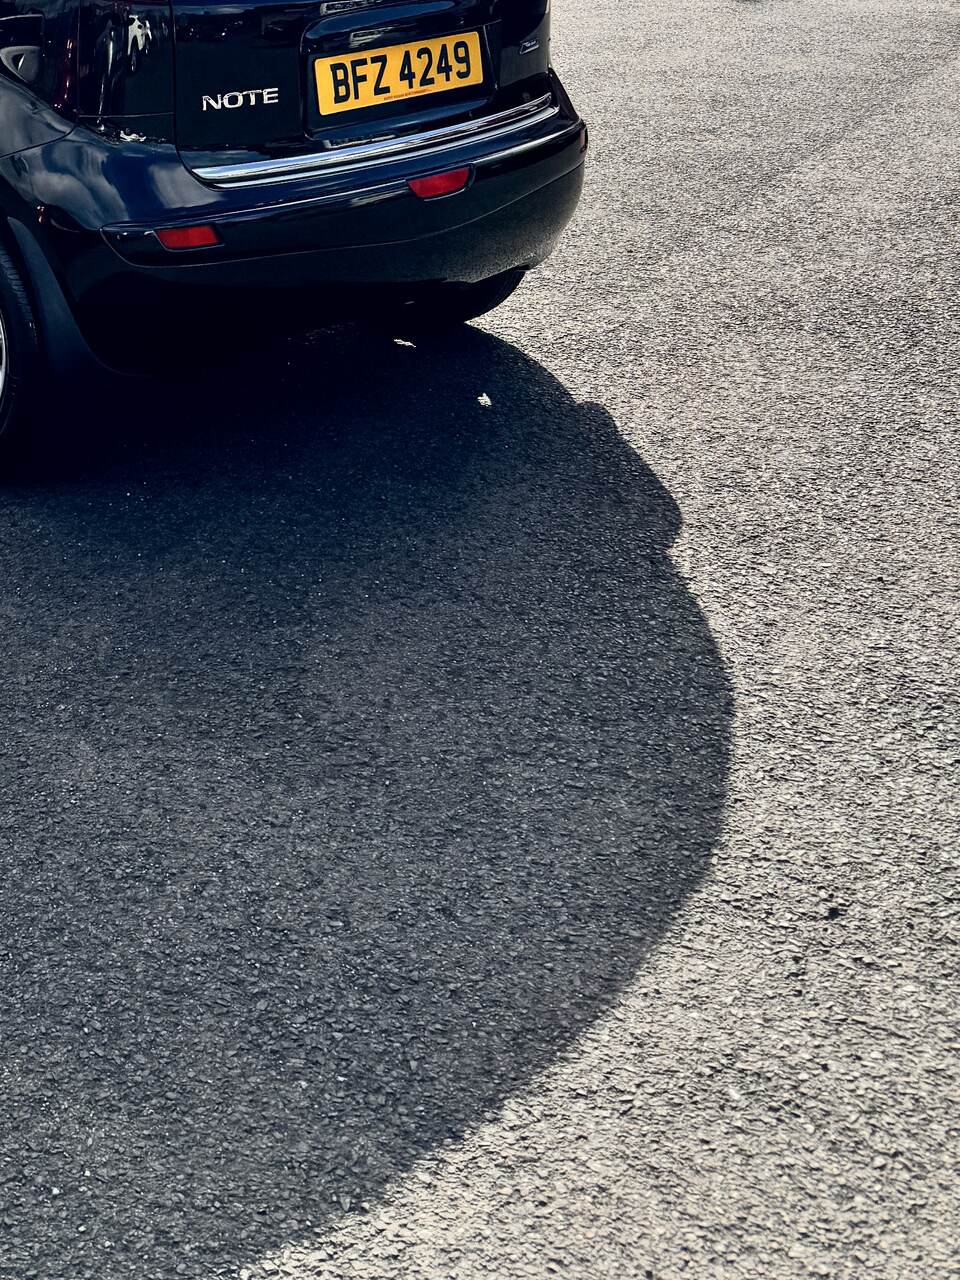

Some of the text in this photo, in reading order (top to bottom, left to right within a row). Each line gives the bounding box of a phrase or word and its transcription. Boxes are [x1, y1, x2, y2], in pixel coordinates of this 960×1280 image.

[330, 40, 472, 104] BFZ 4249
[202, 87, 279, 111] NOTE
